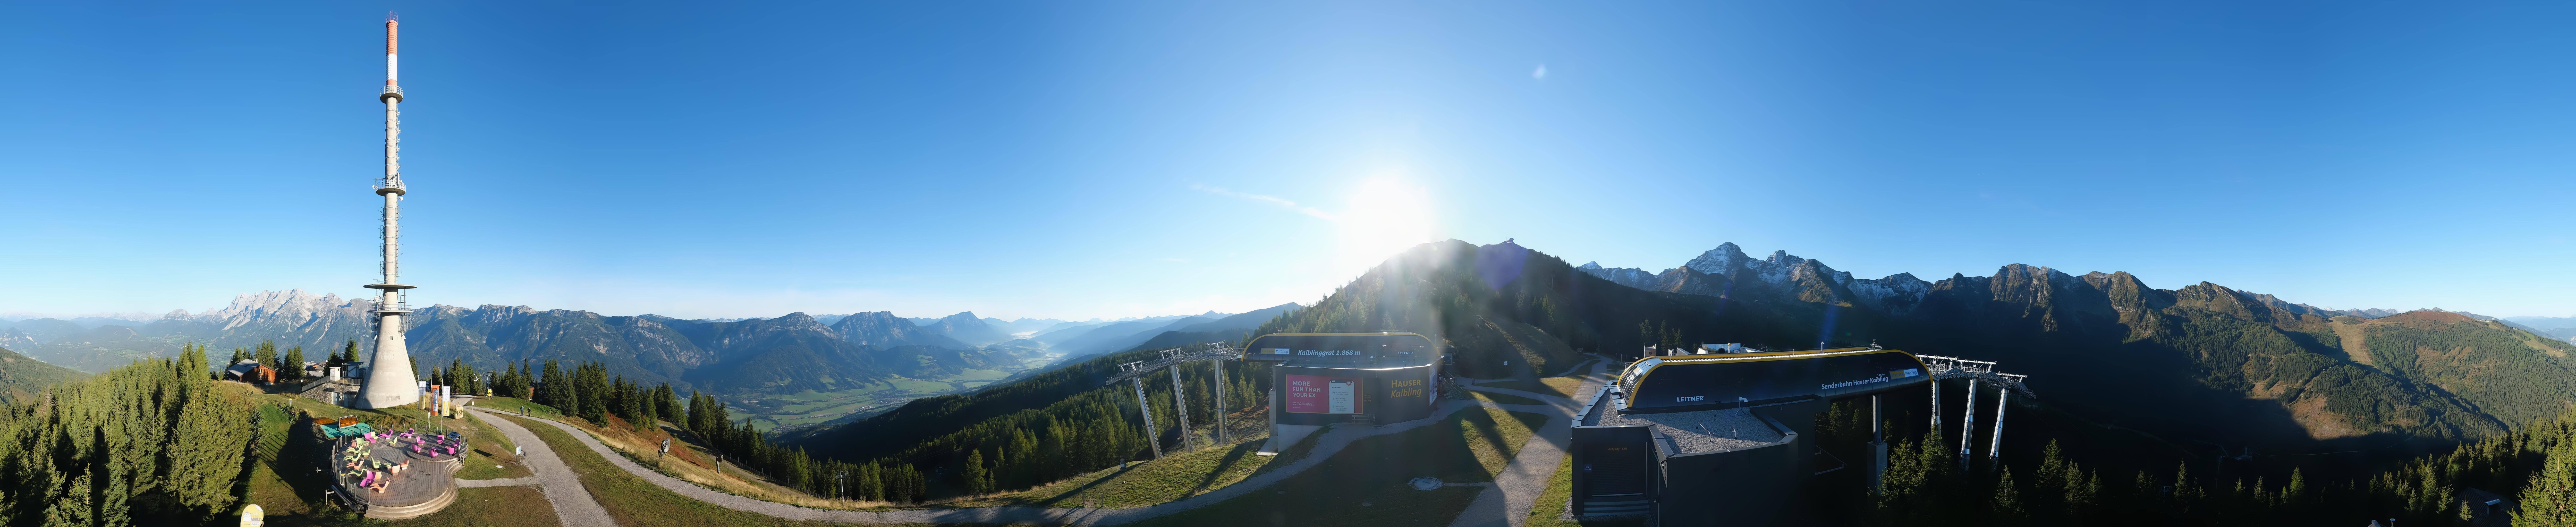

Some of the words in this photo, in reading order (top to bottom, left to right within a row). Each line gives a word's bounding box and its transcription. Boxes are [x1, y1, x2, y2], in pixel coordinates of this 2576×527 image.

[1391, 379, 1421, 388] HAUSER
[1822, 381, 1852, 390] Senderbahn
[1391, 388, 1421, 398] Kaibling
